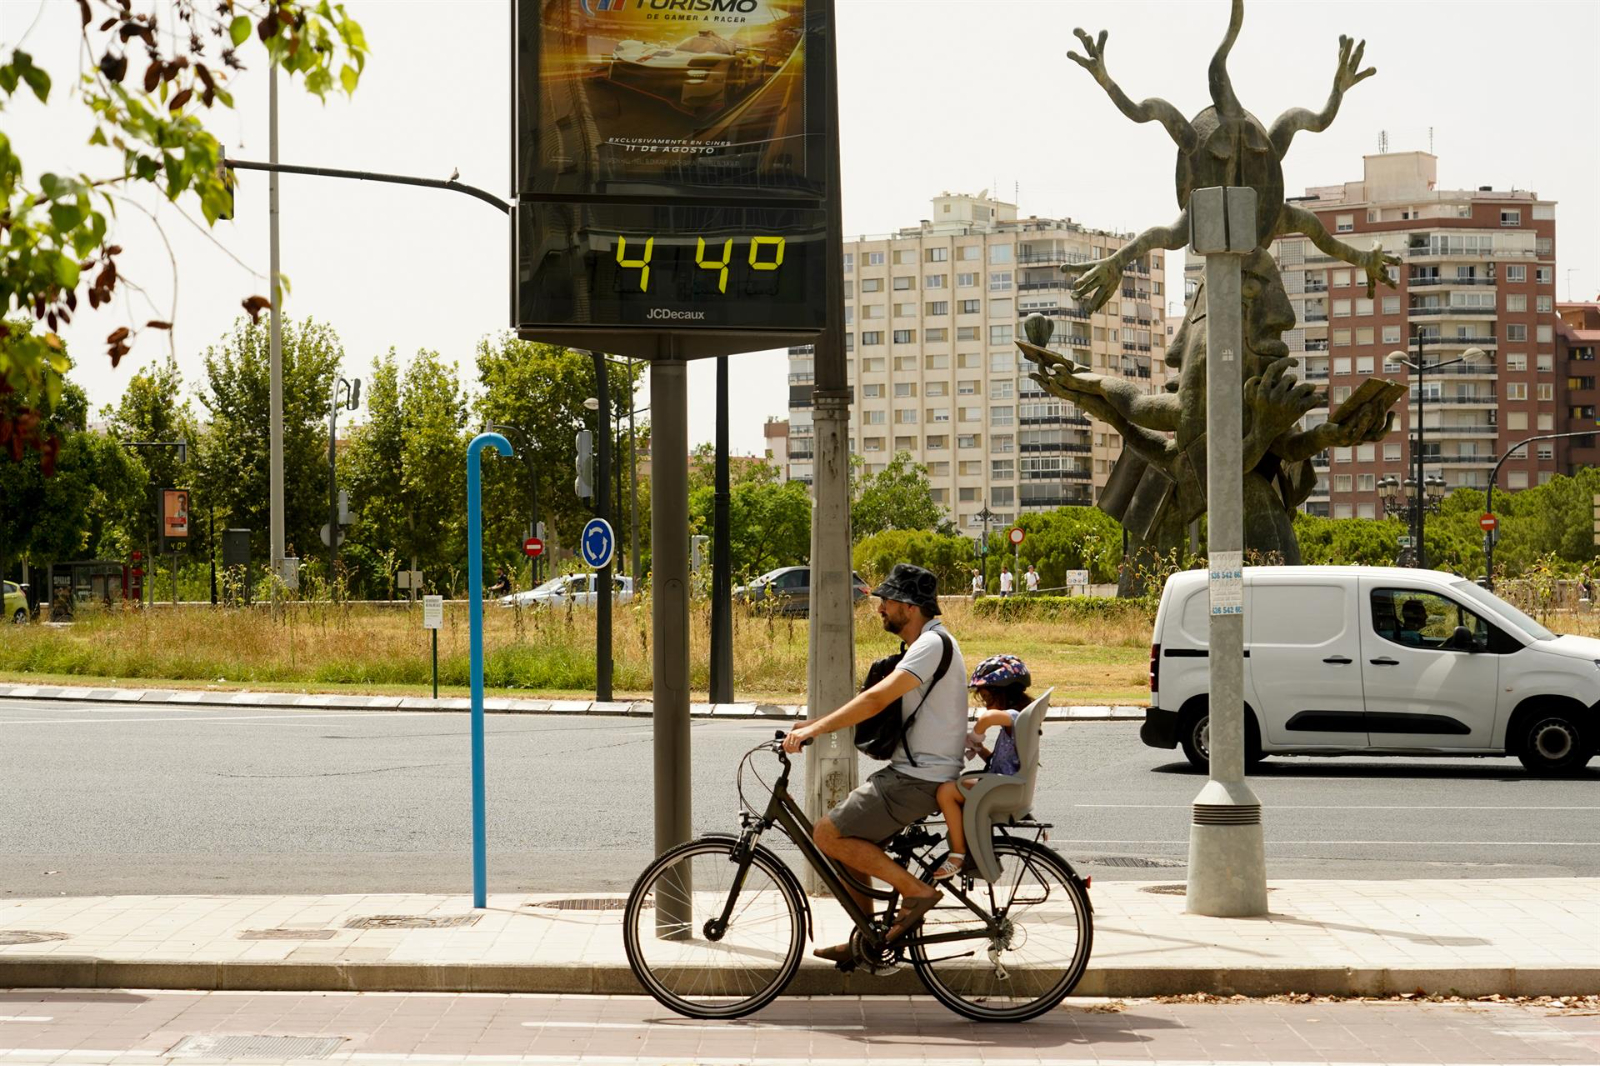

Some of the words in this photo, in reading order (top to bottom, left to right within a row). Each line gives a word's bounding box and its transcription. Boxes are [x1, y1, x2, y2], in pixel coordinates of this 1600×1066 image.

[636, 0, 758, 13] TURISMO
[713, 15, 747, 23] RACER
[608, 137, 688, 145] EXCLUSIVAMENTE
[641, 145, 658, 153] DE
[662, 146, 715, 154] AGOSTO
[646, 308, 705, 321] JCDecaux
[1223, 606, 1234, 614] 542
